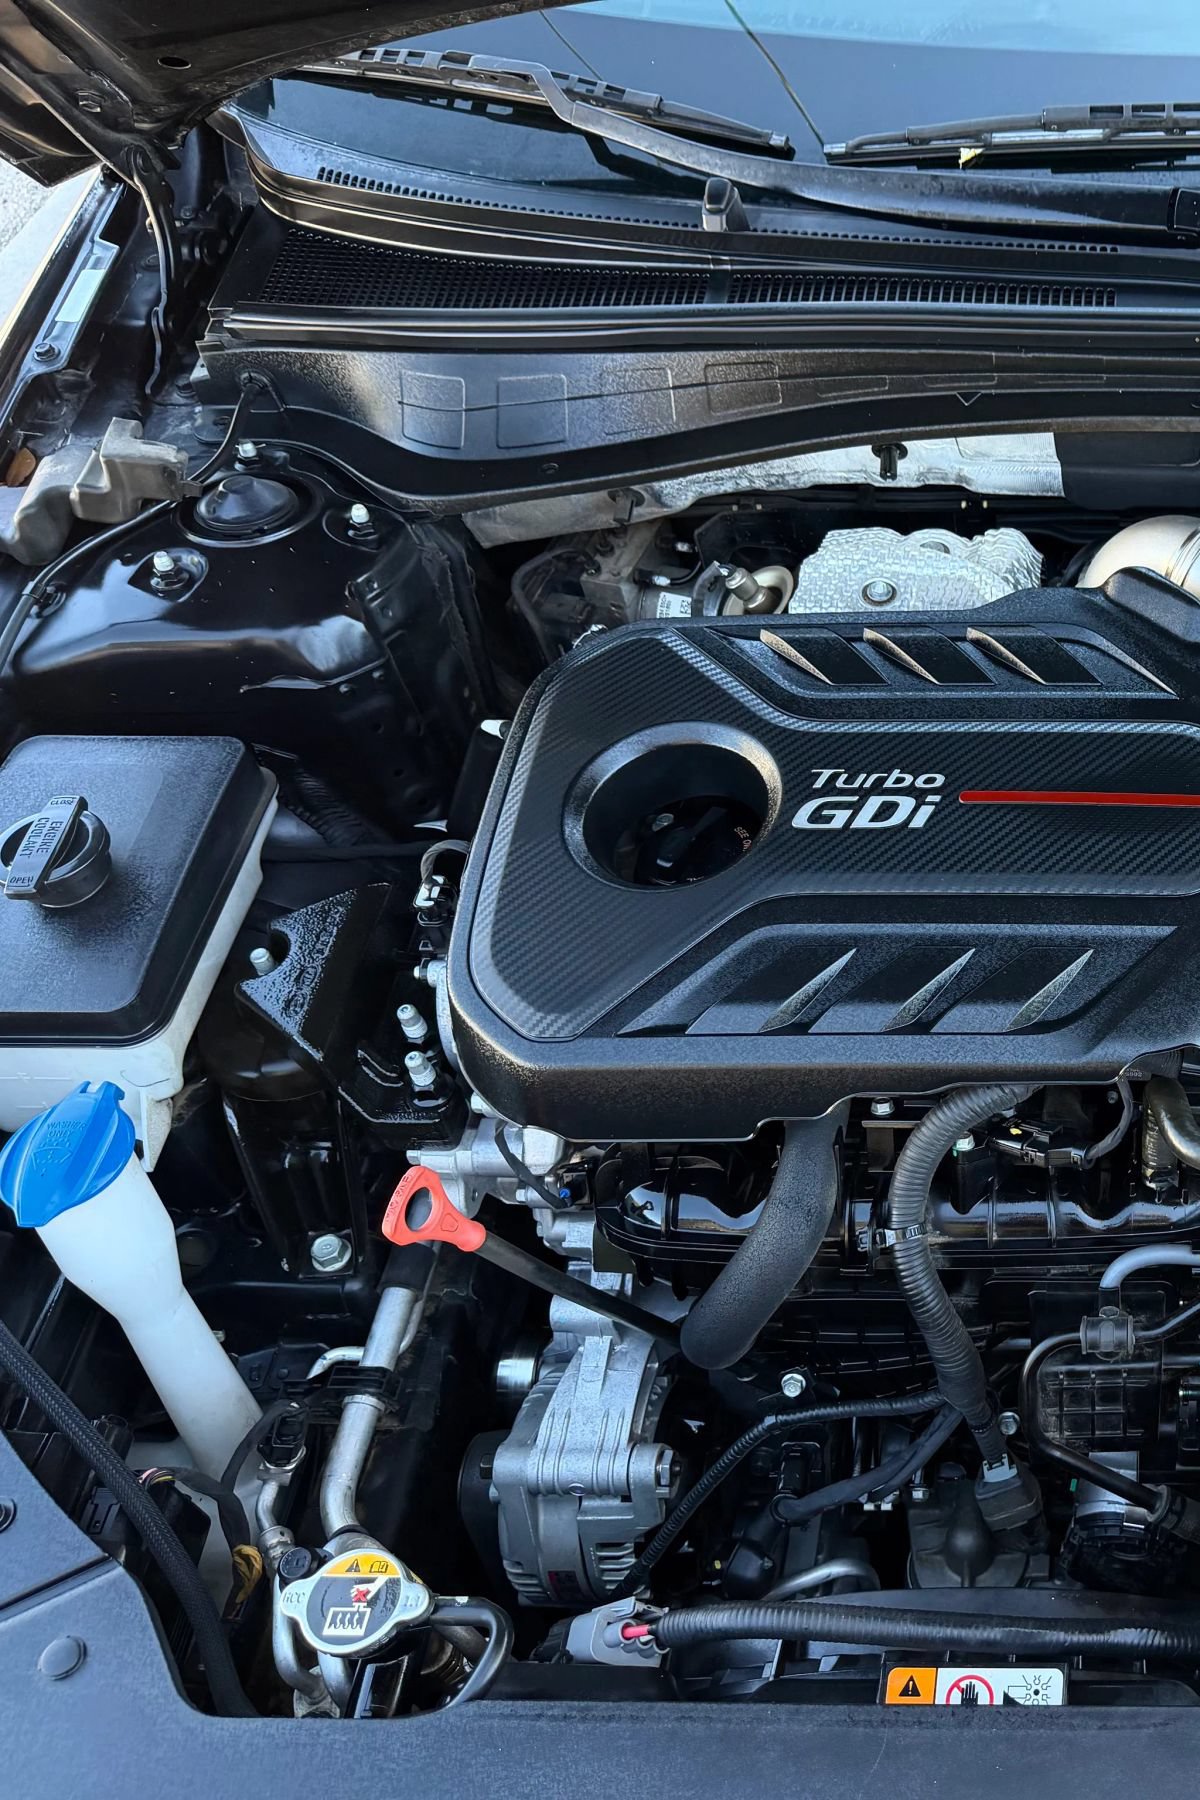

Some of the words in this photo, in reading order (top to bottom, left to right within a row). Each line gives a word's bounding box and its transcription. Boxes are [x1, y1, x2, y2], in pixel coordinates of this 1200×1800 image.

[811, 768, 945, 789] Turbo
[792, 795, 942, 829] GDi
[47, 1121, 87, 1132] WASHER
[48, 1130, 73, 1138] ONLY
